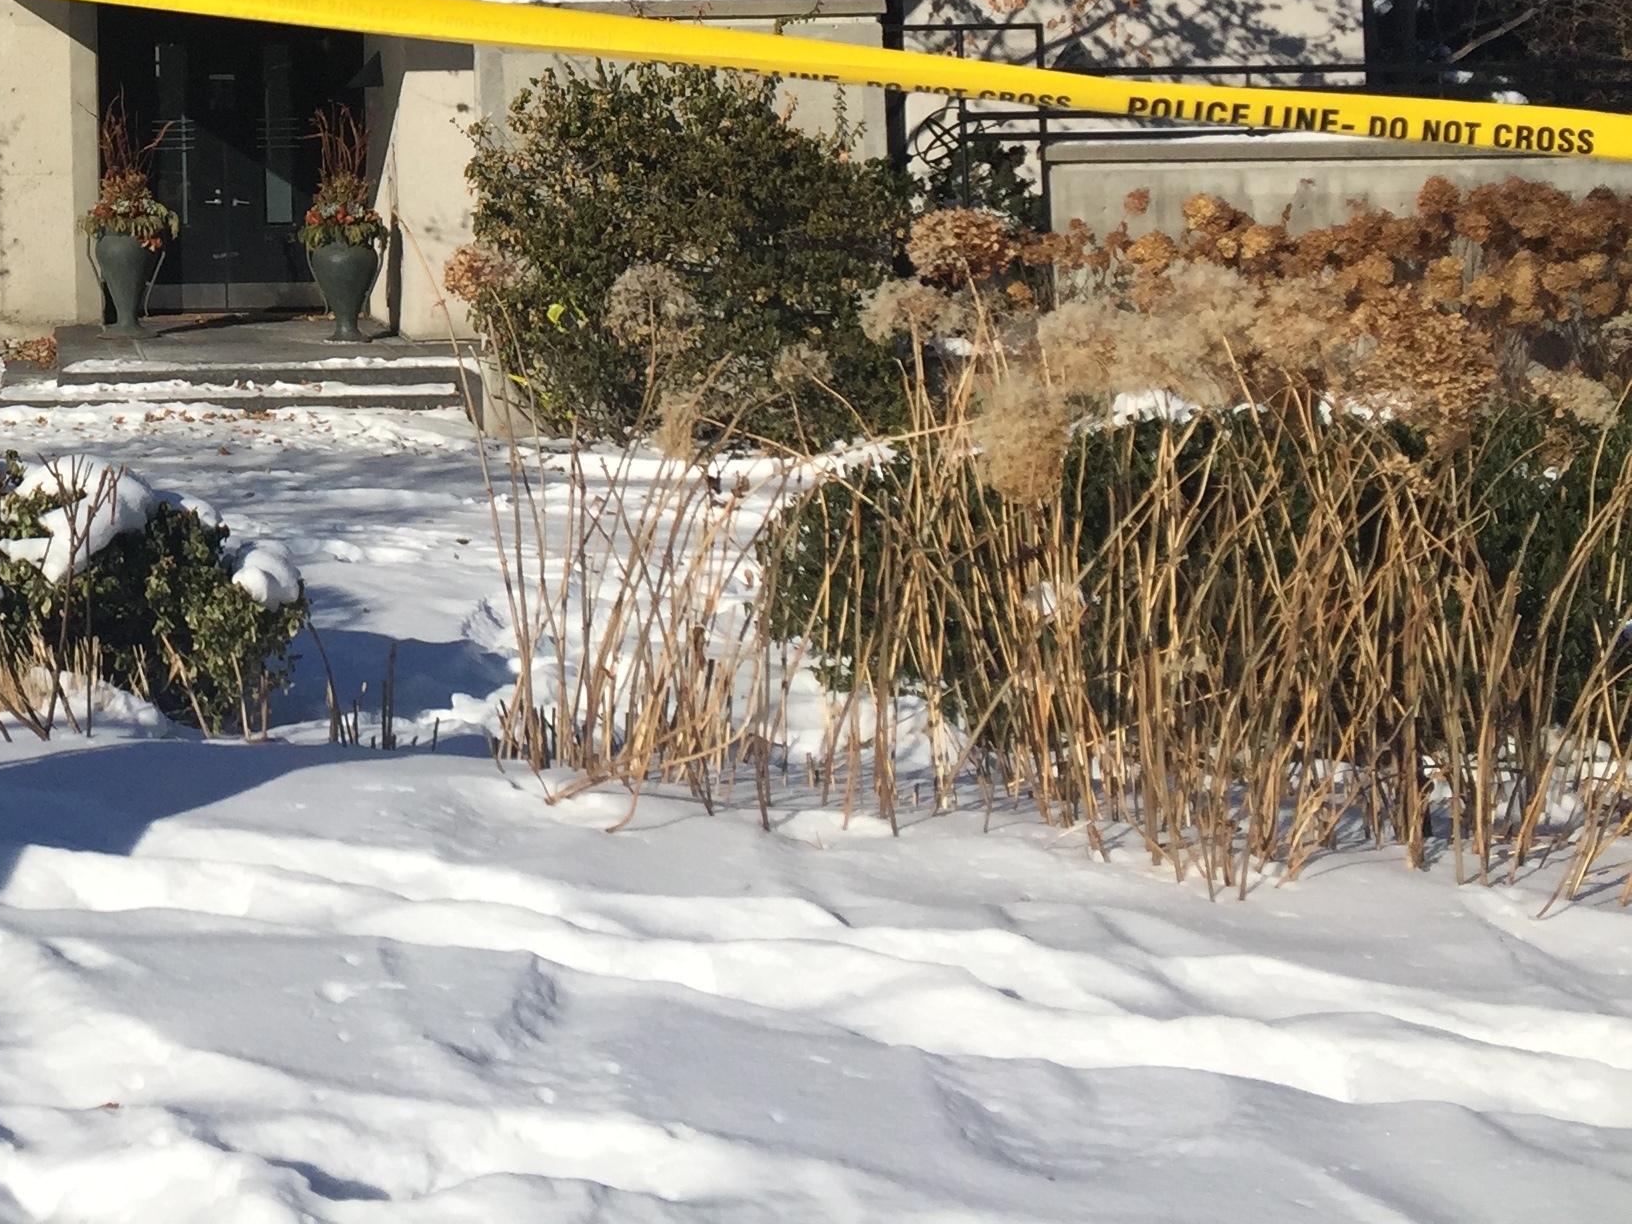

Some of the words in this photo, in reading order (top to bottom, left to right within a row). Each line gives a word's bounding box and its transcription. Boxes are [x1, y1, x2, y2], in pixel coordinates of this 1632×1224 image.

[1128, 96, 1251, 125] POLICE
[1264, 105, 1356, 132] LINE-
[1369, 115, 1409, 140] DO
[1421, 119, 1482, 145] NOT
[1493, 123, 1595, 155] CROSS
